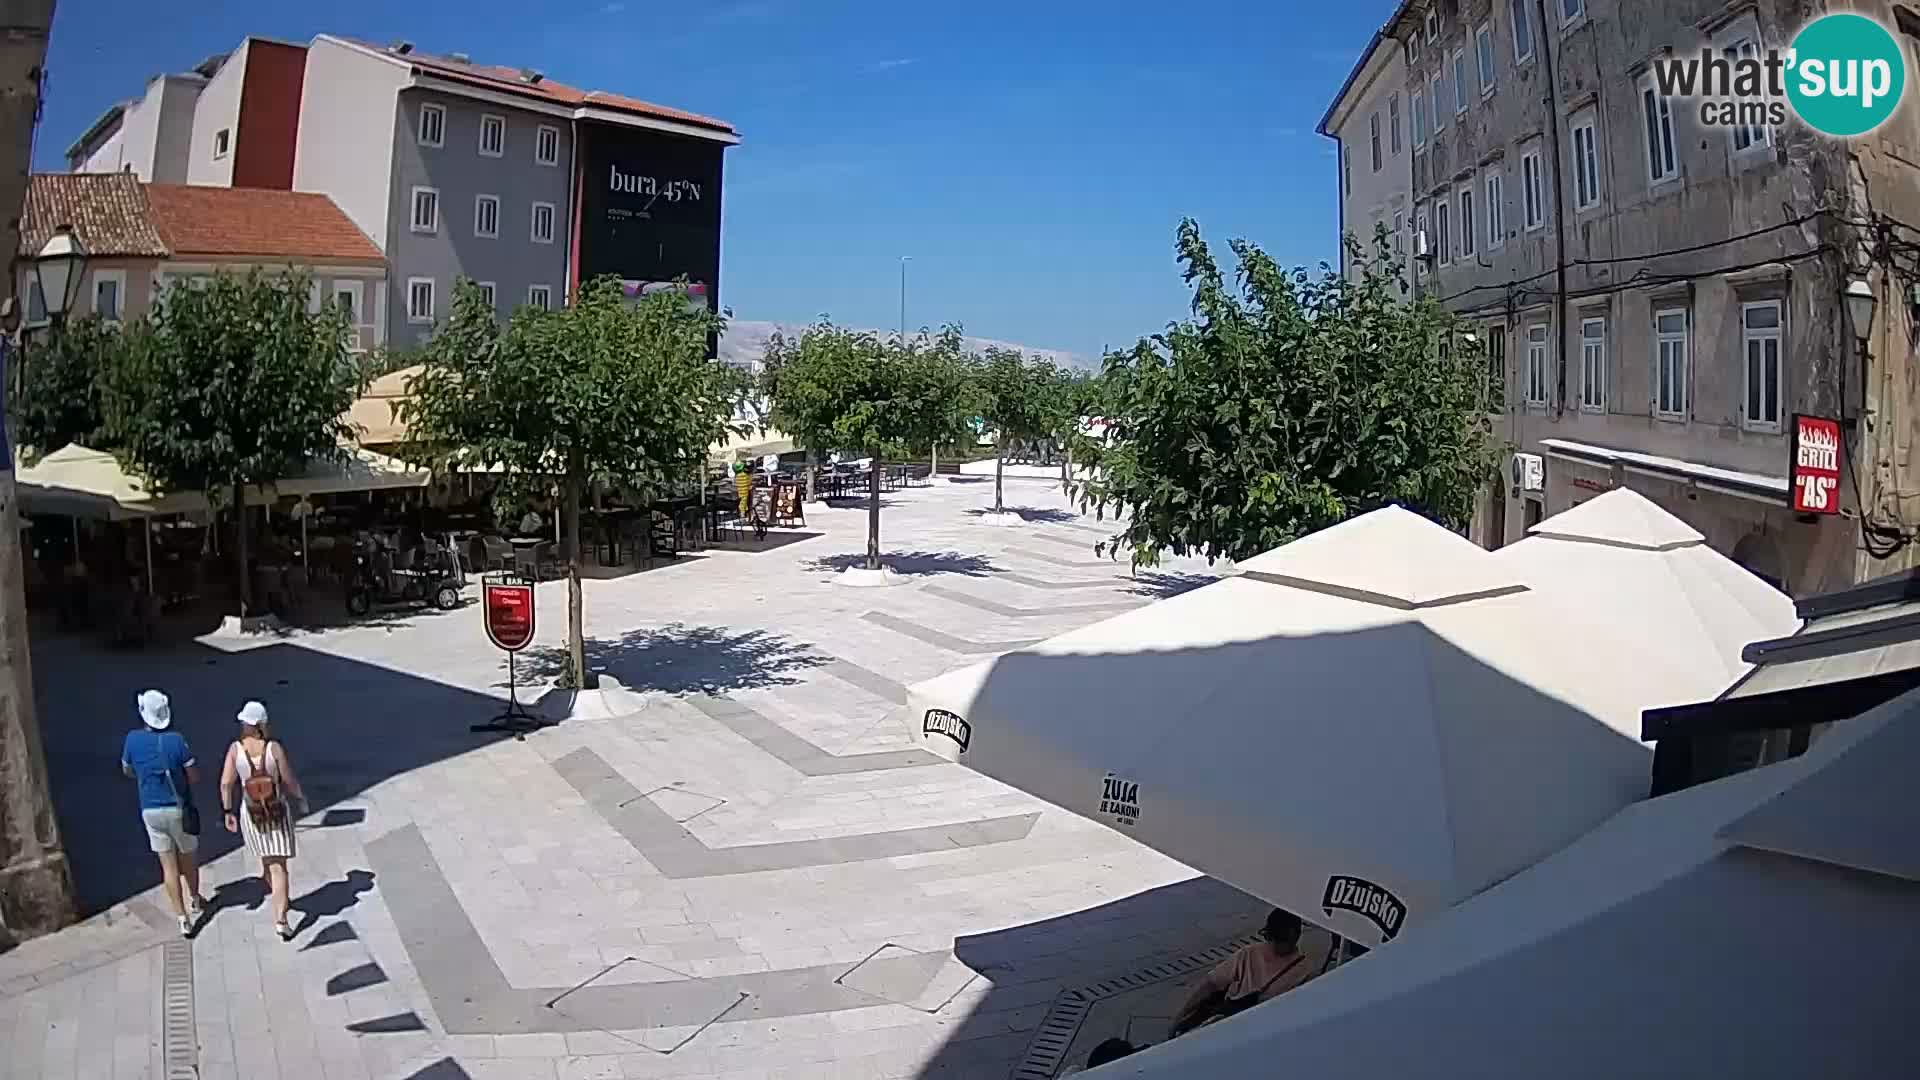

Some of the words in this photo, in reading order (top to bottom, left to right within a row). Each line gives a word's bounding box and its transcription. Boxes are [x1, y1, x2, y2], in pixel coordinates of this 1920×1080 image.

[610, 164, 656, 195] bura
[1797, 446, 1838, 471] GRILL
[484, 577, 504, 585] WINE
[506, 577, 523, 585] BAR
[926, 711, 967, 743] Ožujsko
[1102, 773, 1139, 805] ŽUJA
[1099, 800, 1108, 813] JE
[1110, 802, 1140, 818] ZAKON!
[1330, 879, 1399, 929] Ožujsko
